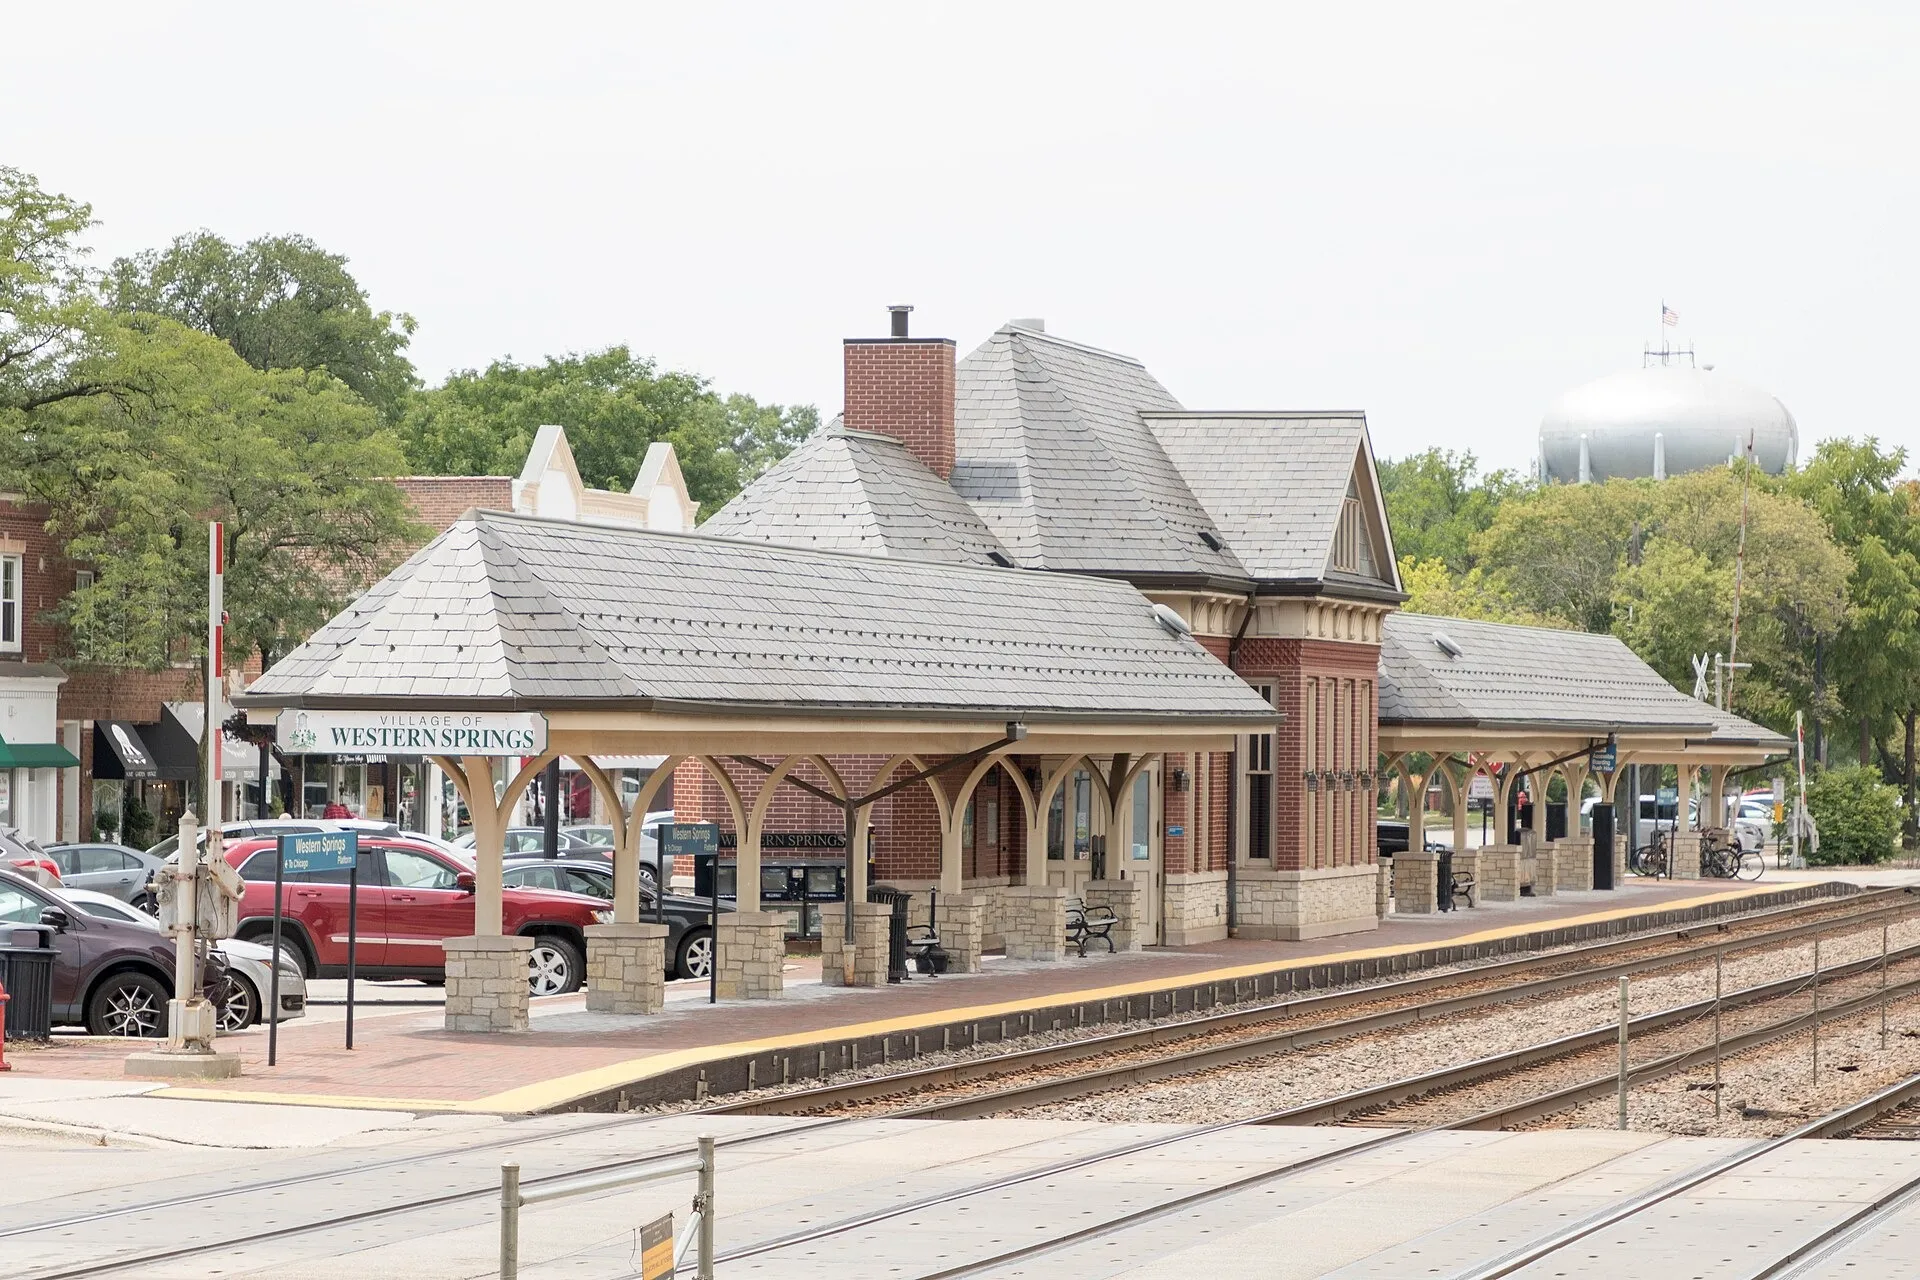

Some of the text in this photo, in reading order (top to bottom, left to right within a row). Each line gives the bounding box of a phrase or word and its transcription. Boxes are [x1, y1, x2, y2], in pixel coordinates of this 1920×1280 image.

[380, 715, 483, 727] VILLAGE OF
[331, 727, 535, 749] WESTERN SPRINGS
[672, 826, 711, 844] Western Springs
[788, 834, 845, 848] SPRINGS
[296, 836, 347, 856] Western Springs
[294, 859, 309, 870] Chicago
